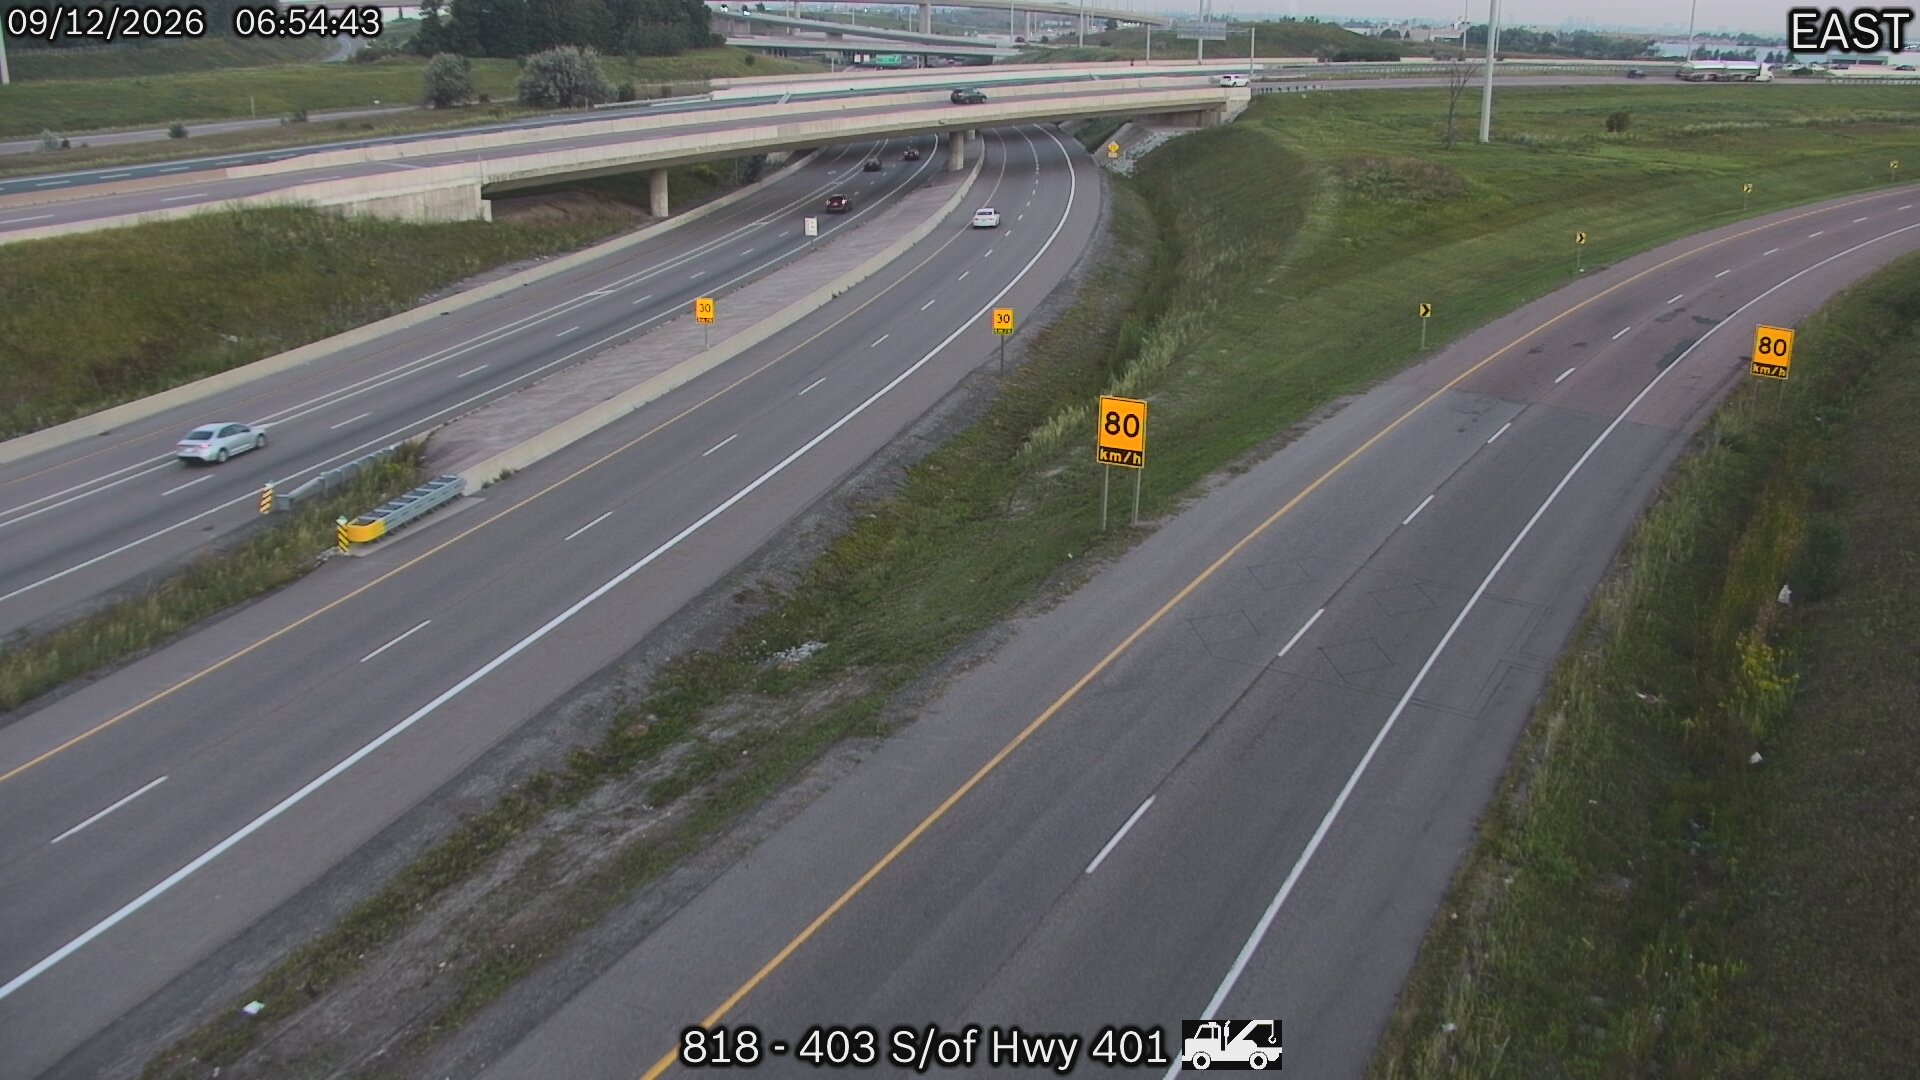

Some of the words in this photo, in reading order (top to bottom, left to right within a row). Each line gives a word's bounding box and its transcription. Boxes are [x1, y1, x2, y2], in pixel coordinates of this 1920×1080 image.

[699, 303, 711, 313] 30
[997, 313, 1010, 324] 30
[1759, 336, 1787, 357] 80
[1752, 363, 1787, 377] km/h
[1105, 411, 1140, 438] 80
[1100, 448, 1142, 465] km/h
